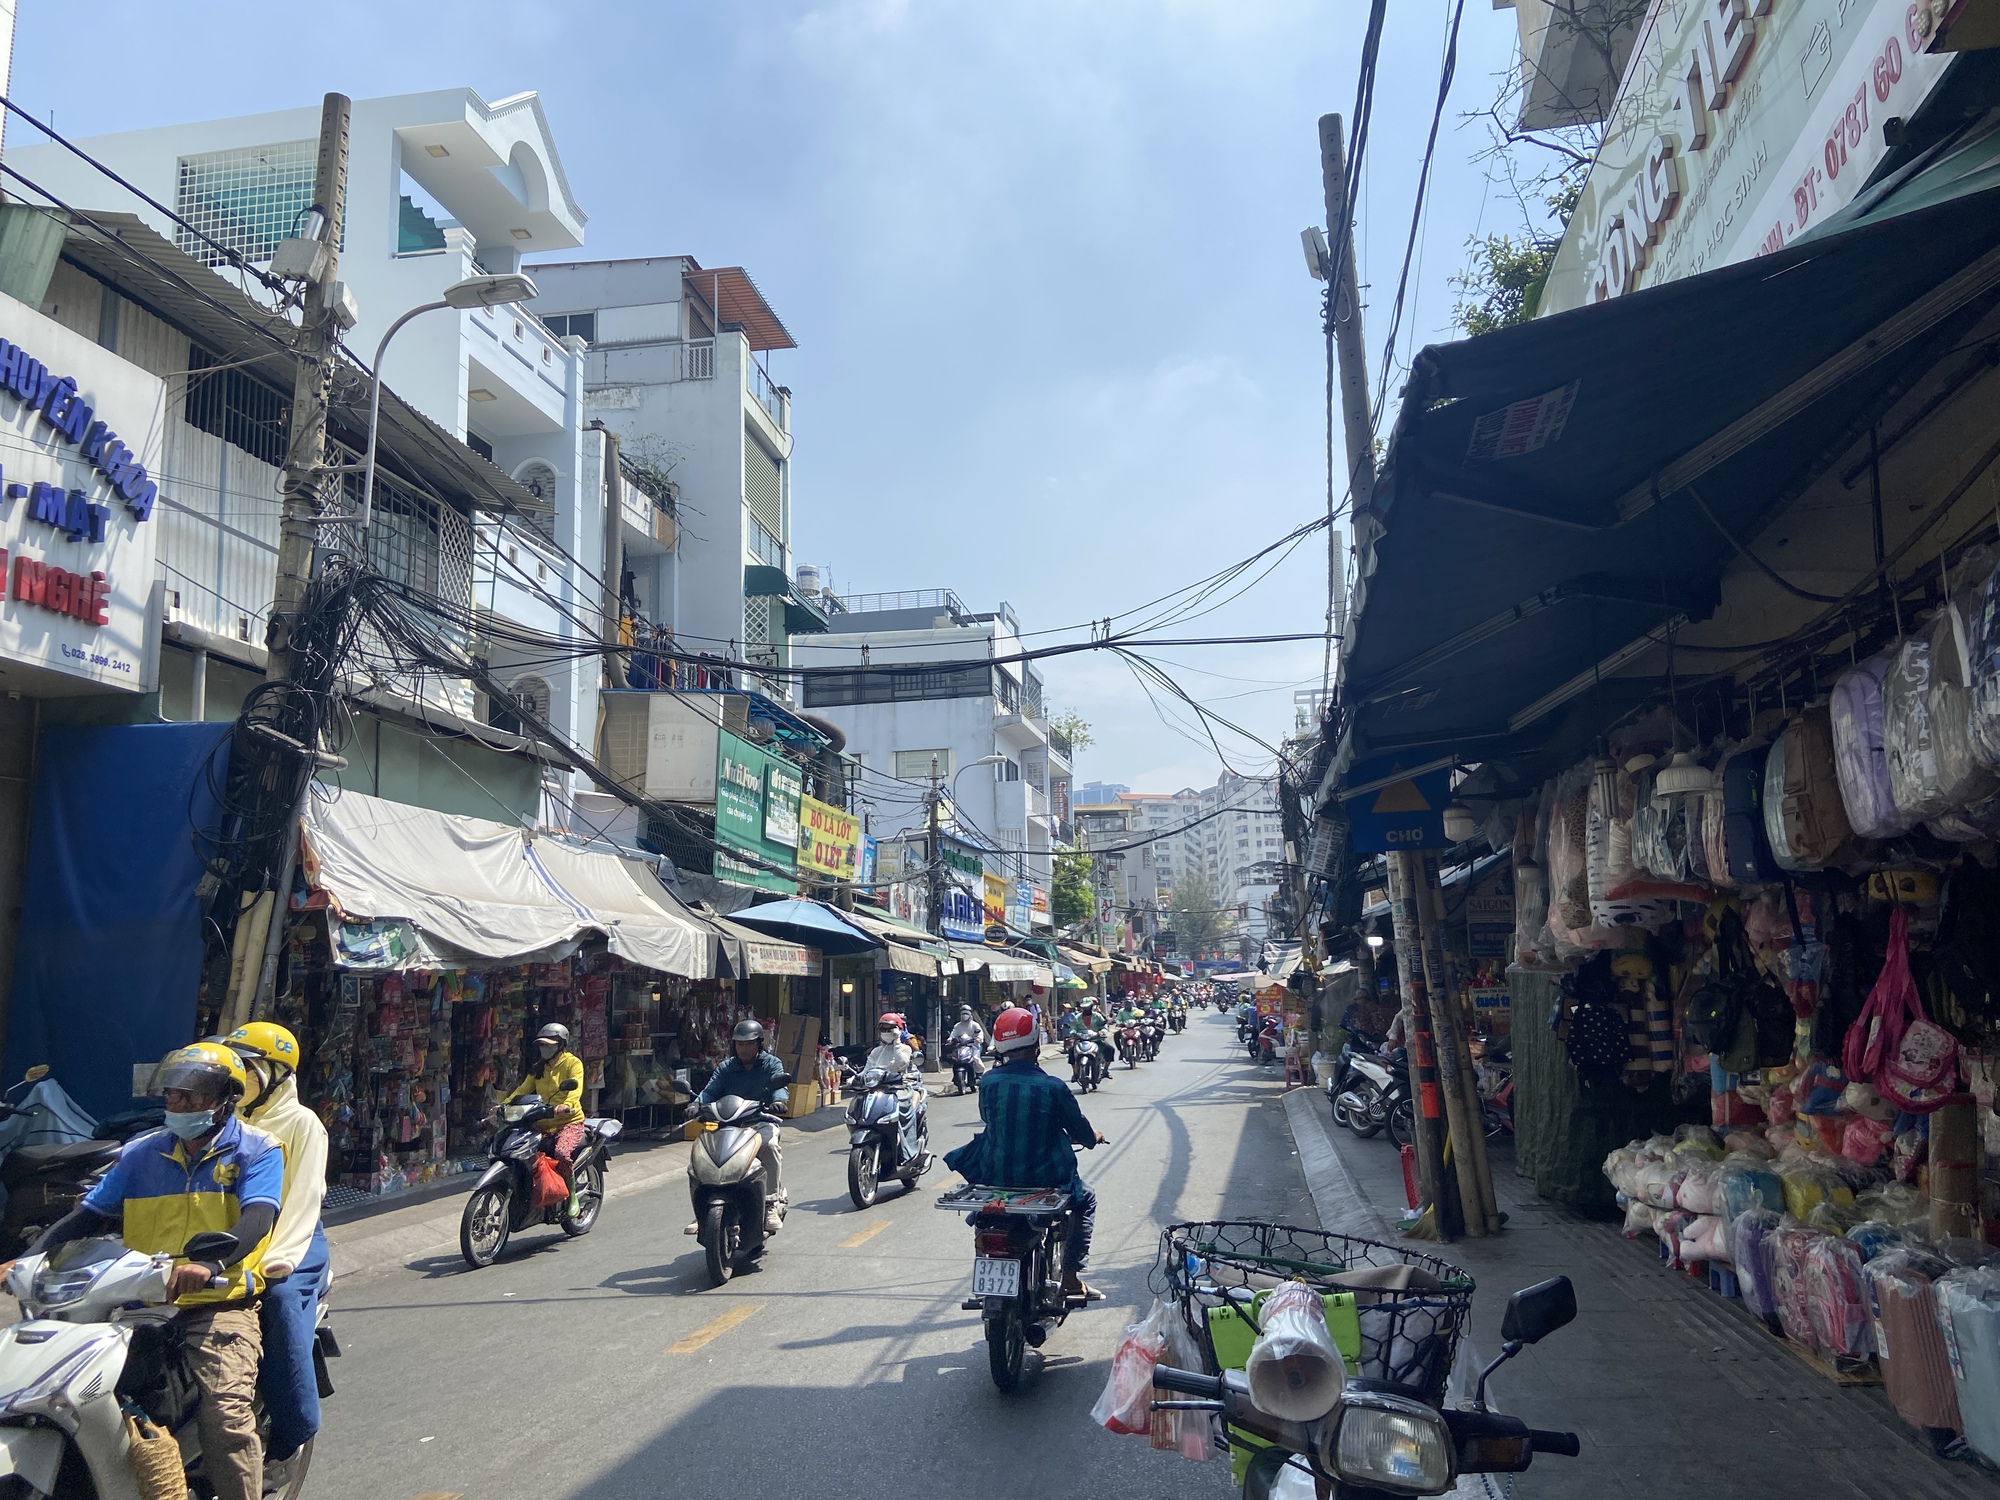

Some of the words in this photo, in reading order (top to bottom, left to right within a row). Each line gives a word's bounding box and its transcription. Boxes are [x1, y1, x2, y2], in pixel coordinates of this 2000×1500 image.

[1824, 81, 1869, 181] 0787
[1873, 36, 1903, 103] 60
[1706, 201, 1734, 259] HỌC
[1735, 140, 1768, 211] SINH
[80, 420, 158, 522] KHOA
[71, 648, 88, 662] 028.
[112, 659, 131, 673] 2412
[1385, 826, 1425, 846] CHỢ
[274, 1034, 294, 1054] be
[978, 1278, 1014, 1294] 8372
